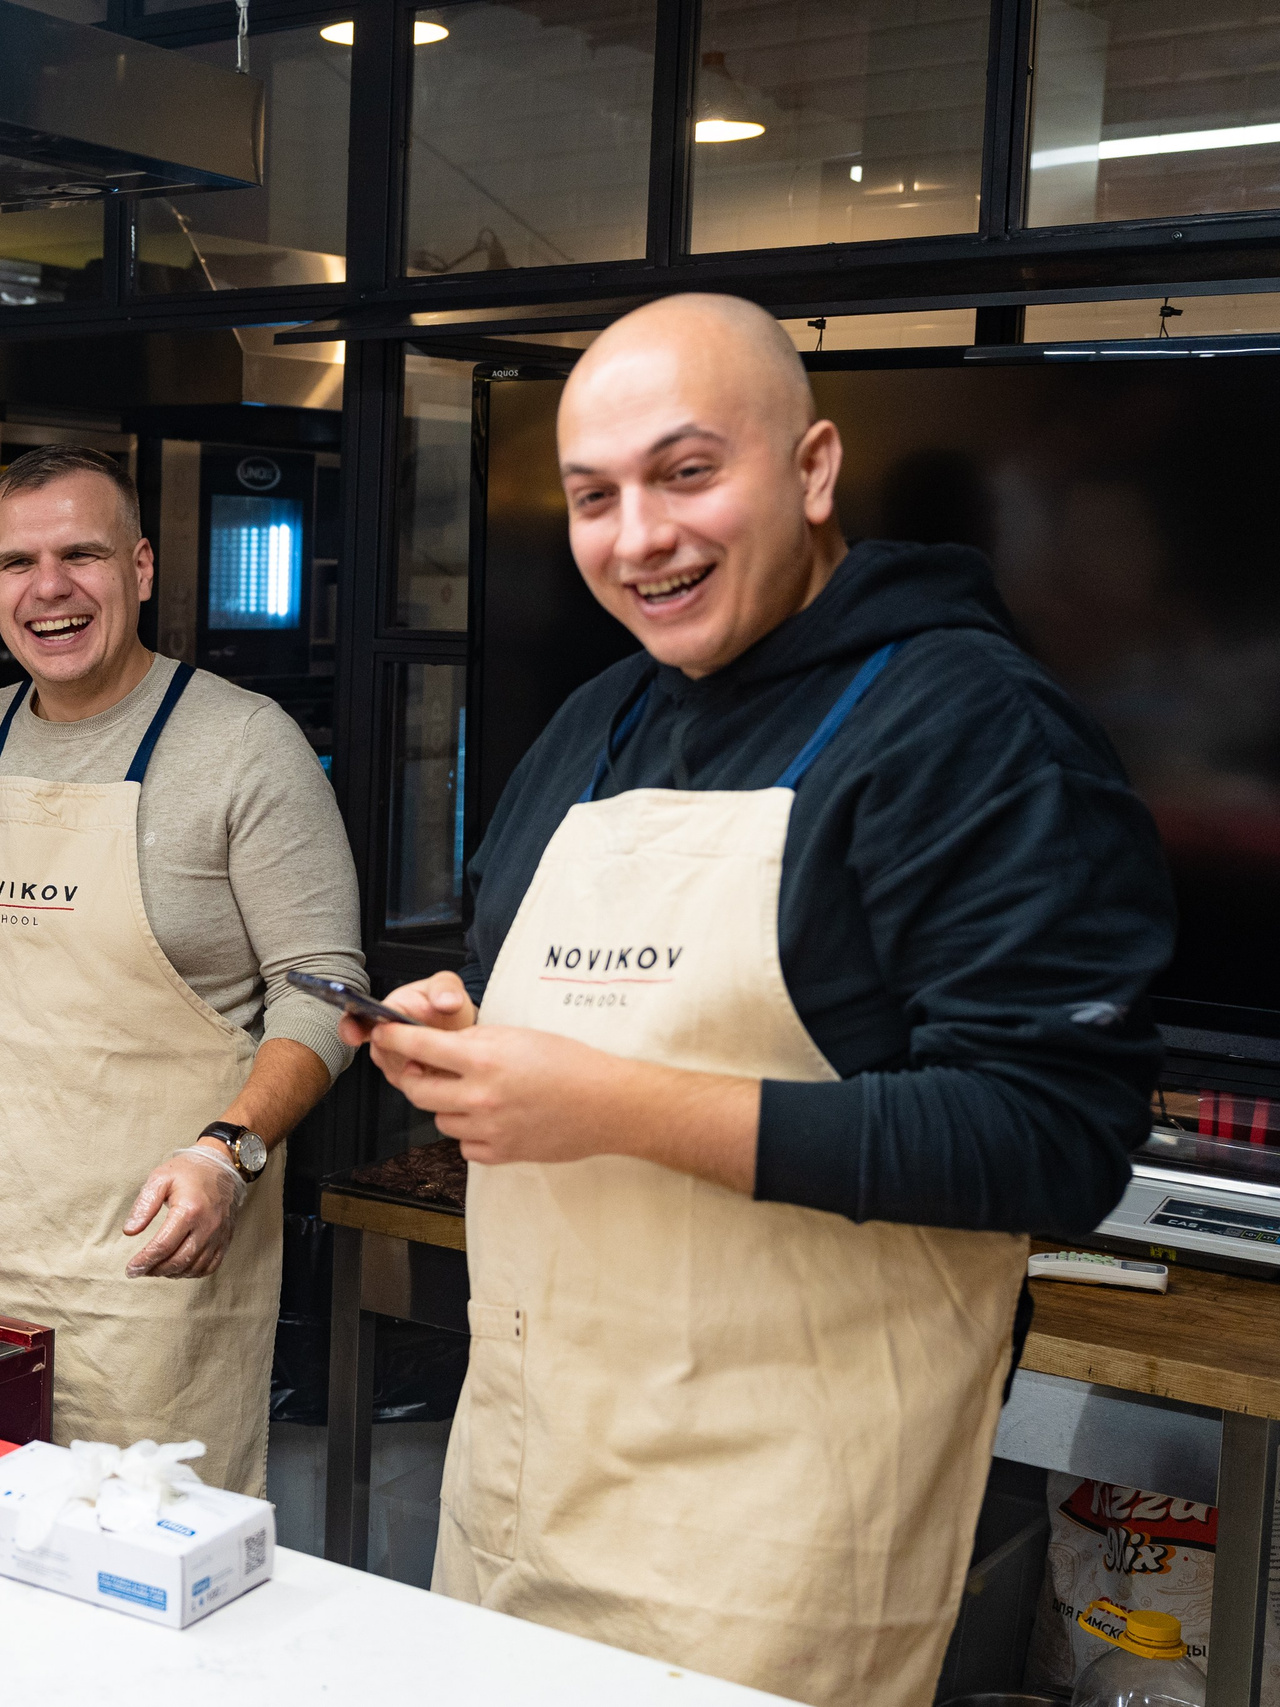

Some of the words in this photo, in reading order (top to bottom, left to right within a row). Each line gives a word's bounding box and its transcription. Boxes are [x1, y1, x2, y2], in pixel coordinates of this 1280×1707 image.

[492, 369, 519, 378] AQUOS
[545, 945, 683, 971] NOVIKOV
[563, 992, 627, 1008] SCHOOL
[1167, 1219, 1198, 1228] CAS
[1105, 1526, 1166, 1573] Mix
